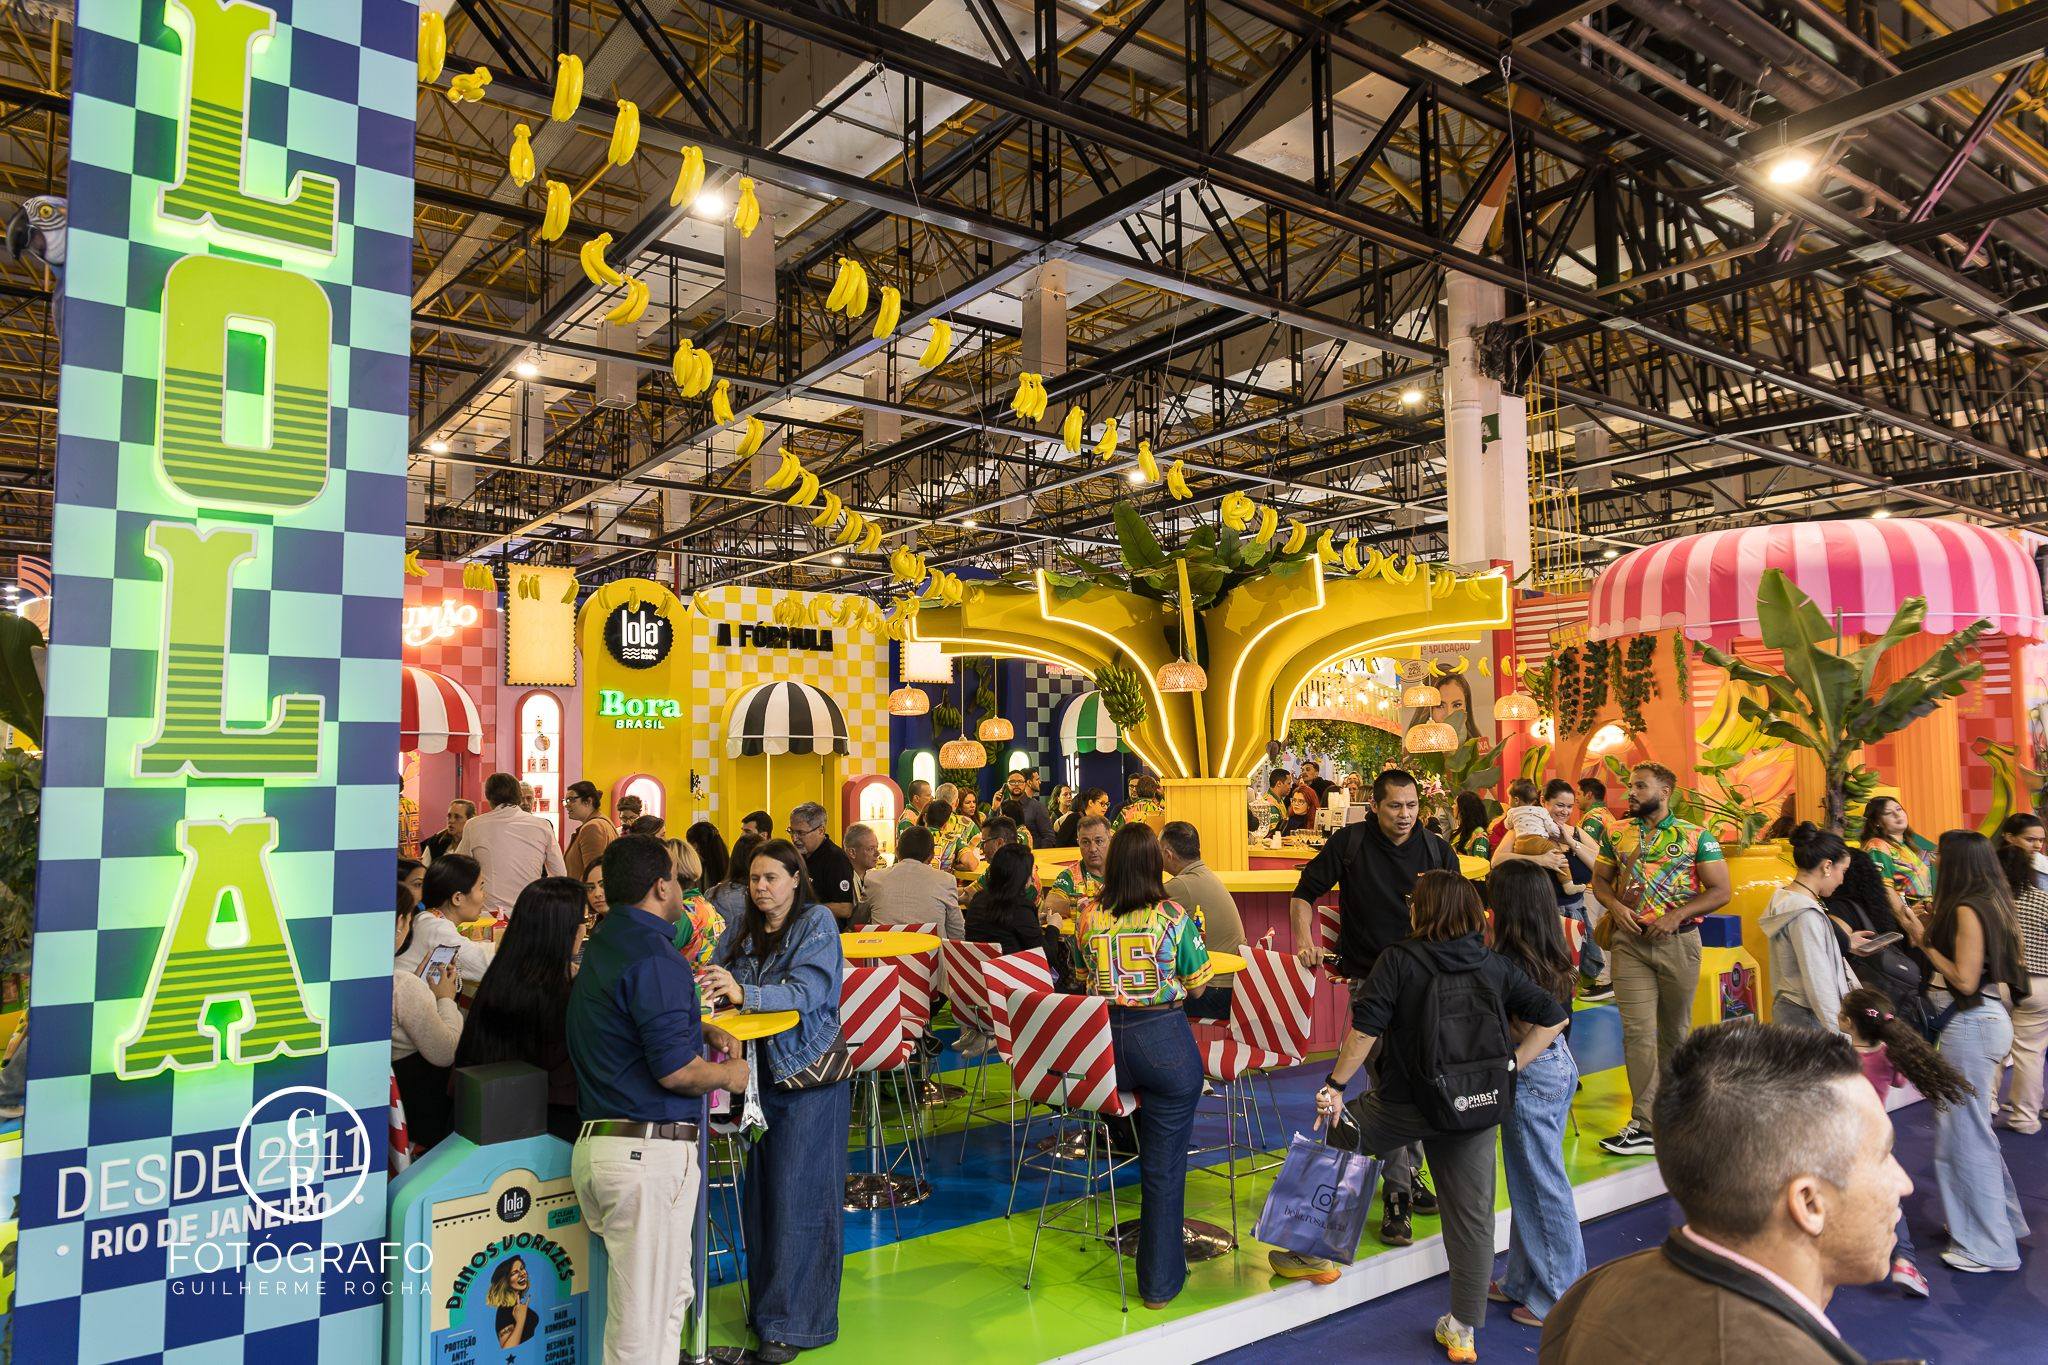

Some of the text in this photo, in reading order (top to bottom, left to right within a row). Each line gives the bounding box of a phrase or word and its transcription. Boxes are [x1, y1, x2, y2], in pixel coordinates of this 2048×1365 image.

[116, 0, 340, 1080] LOLA
[622, 609, 659, 648] lola
[738, 620, 834, 652] FÓRMULA
[599, 689, 683, 718] Bora
[615, 719, 665, 730] BRASIL
[1088, 933, 1161, 999] 15
[56, 1143, 240, 1220] DESDE
[504, 1191, 523, 1214] lola
[90, 1192, 333, 1260] RIO DE JANEIRO
[446, 1231, 576, 1310] DANOS VORAZES
[443, 1335, 477, 1354] PROTEÇÃO
